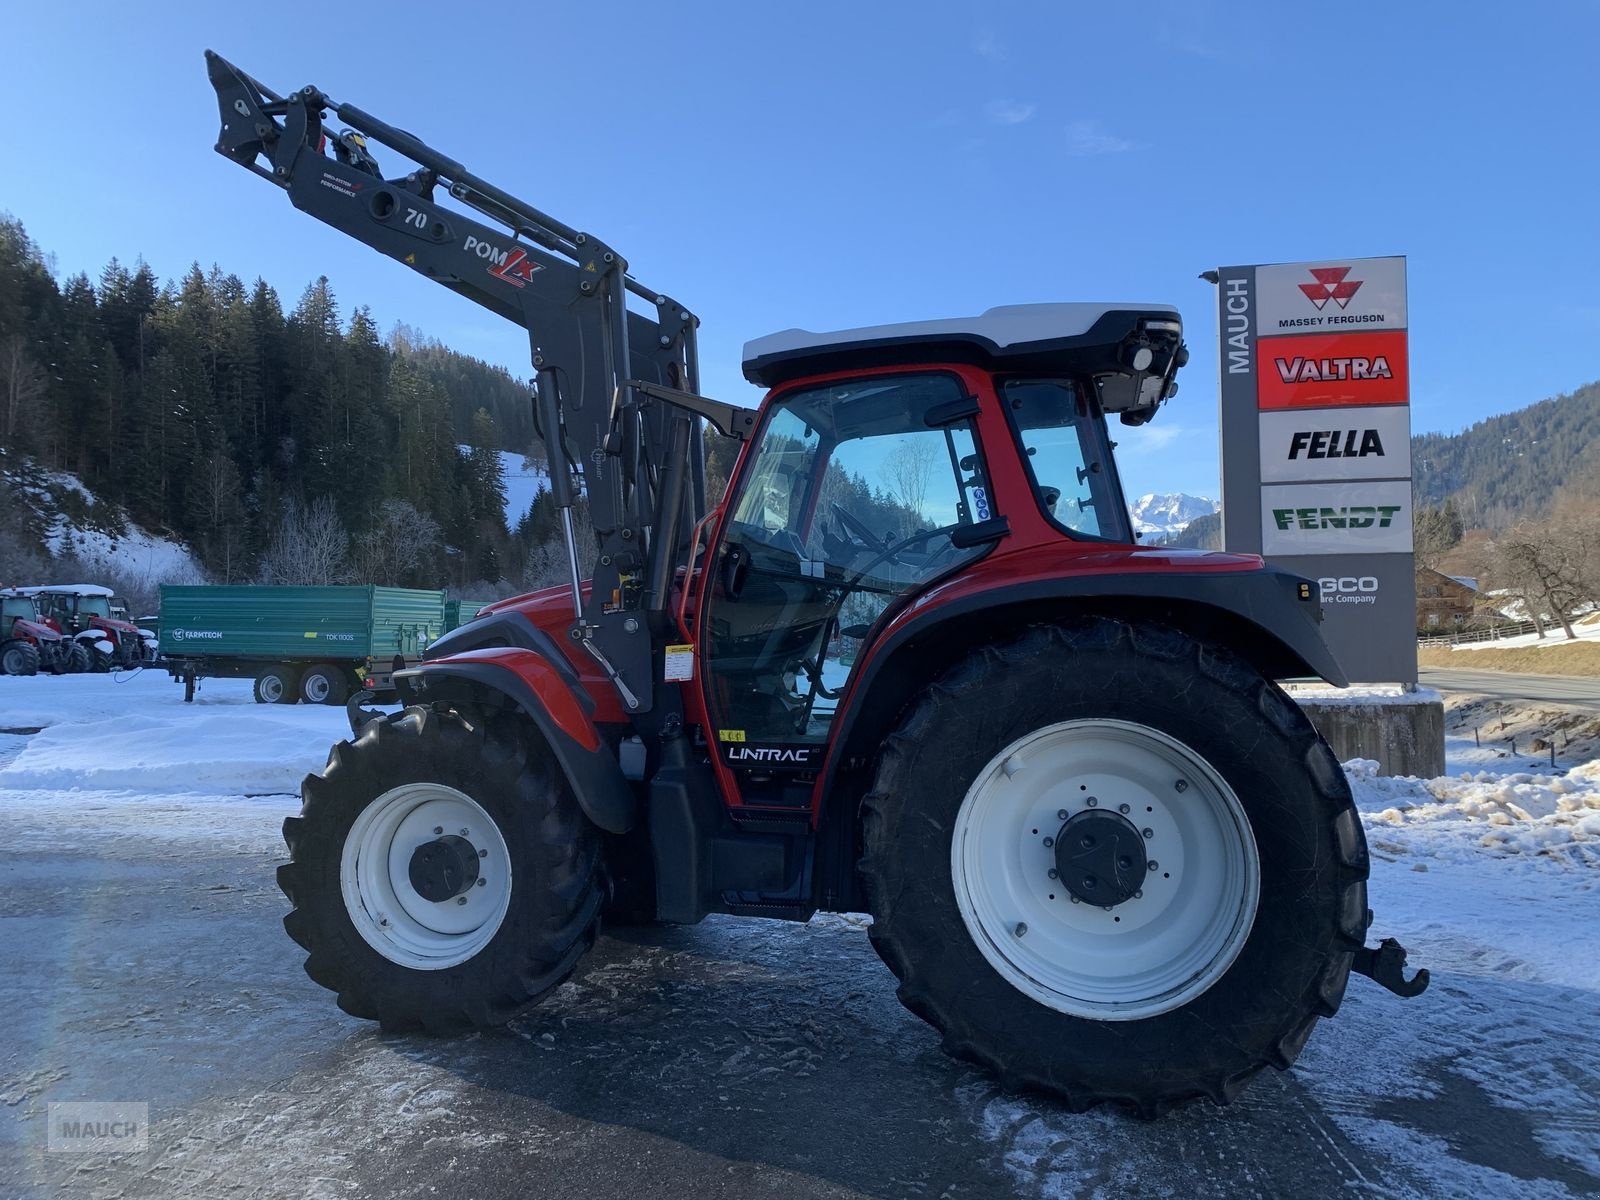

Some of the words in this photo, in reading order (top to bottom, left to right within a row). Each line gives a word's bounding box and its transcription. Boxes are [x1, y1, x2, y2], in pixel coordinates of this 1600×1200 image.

[404, 208, 427, 229] 70
[1226, 278, 1250, 374] MAUCH
[1279, 317, 1324, 328] MASSEY
[1327, 314, 1385, 325] FERGUSON
[1275, 356, 1393, 384] VALTRA
[1287, 429, 1386, 460] FELLA
[1272, 505, 1402, 531] FENDT
[1318, 576, 1379, 593] GCO
[1336, 594, 1377, 605] Company
[185, 631, 223, 640] FARMTECH
[729, 747, 810, 762] LINTRAC
